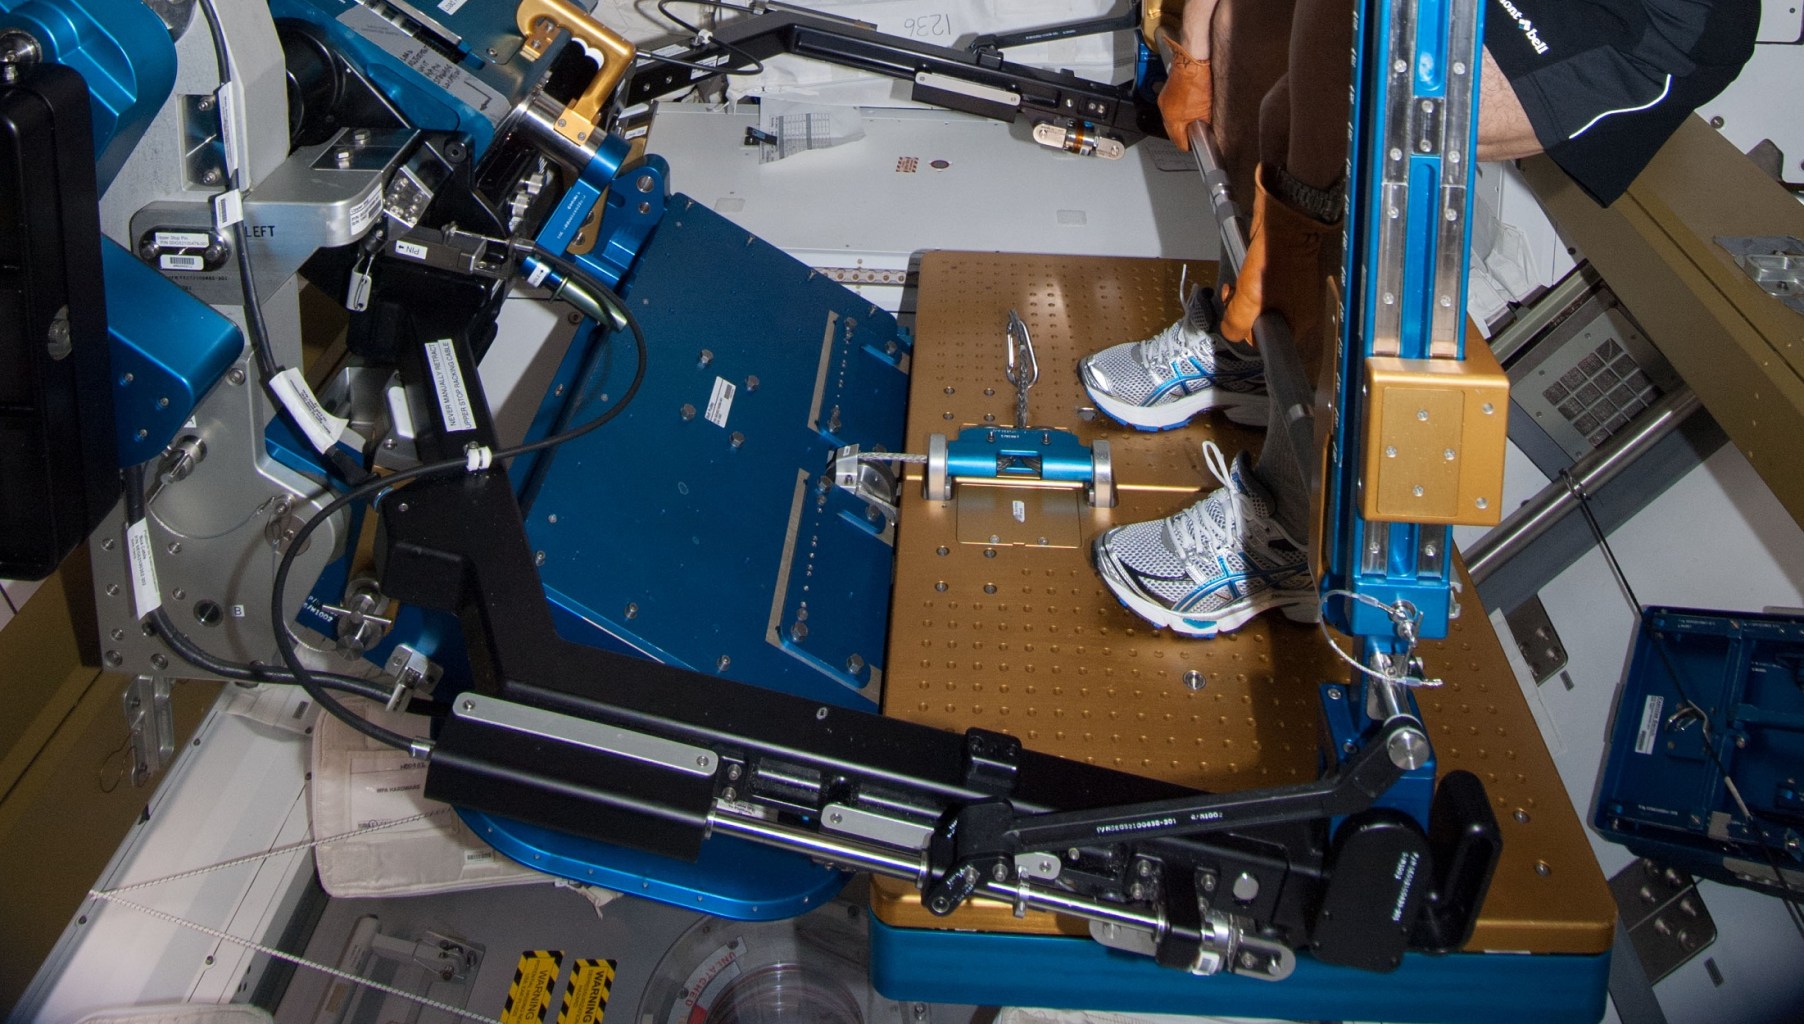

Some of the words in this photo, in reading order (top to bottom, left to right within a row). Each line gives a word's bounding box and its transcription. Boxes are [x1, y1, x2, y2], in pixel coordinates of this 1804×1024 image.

[445, 0, 457, 12] Load
[903, 13, 951, 34] 1236
[1525, 28, 1549, 54] bell
[245, 225, 276, 238] LEFT
[406, 246, 420, 255] PIN
[428, 344, 441, 370] RETRACT
[442, 342, 455, 361] CABLE
[447, 361, 460, 388] RACKING
[437, 370, 450, 404] MANUALLY
[456, 388, 467, 408] STOP
[445, 405, 457, 427] NEVER
[460, 408, 472, 429] UPPER
[234, 606, 242, 616] B
[389, 784, 421, 793] HARDWARE
[684, 950, 736, 1008] UNLATCHED
[525, 969, 549, 1021] WARNING
[582, 970, 605, 1024] WARNING
